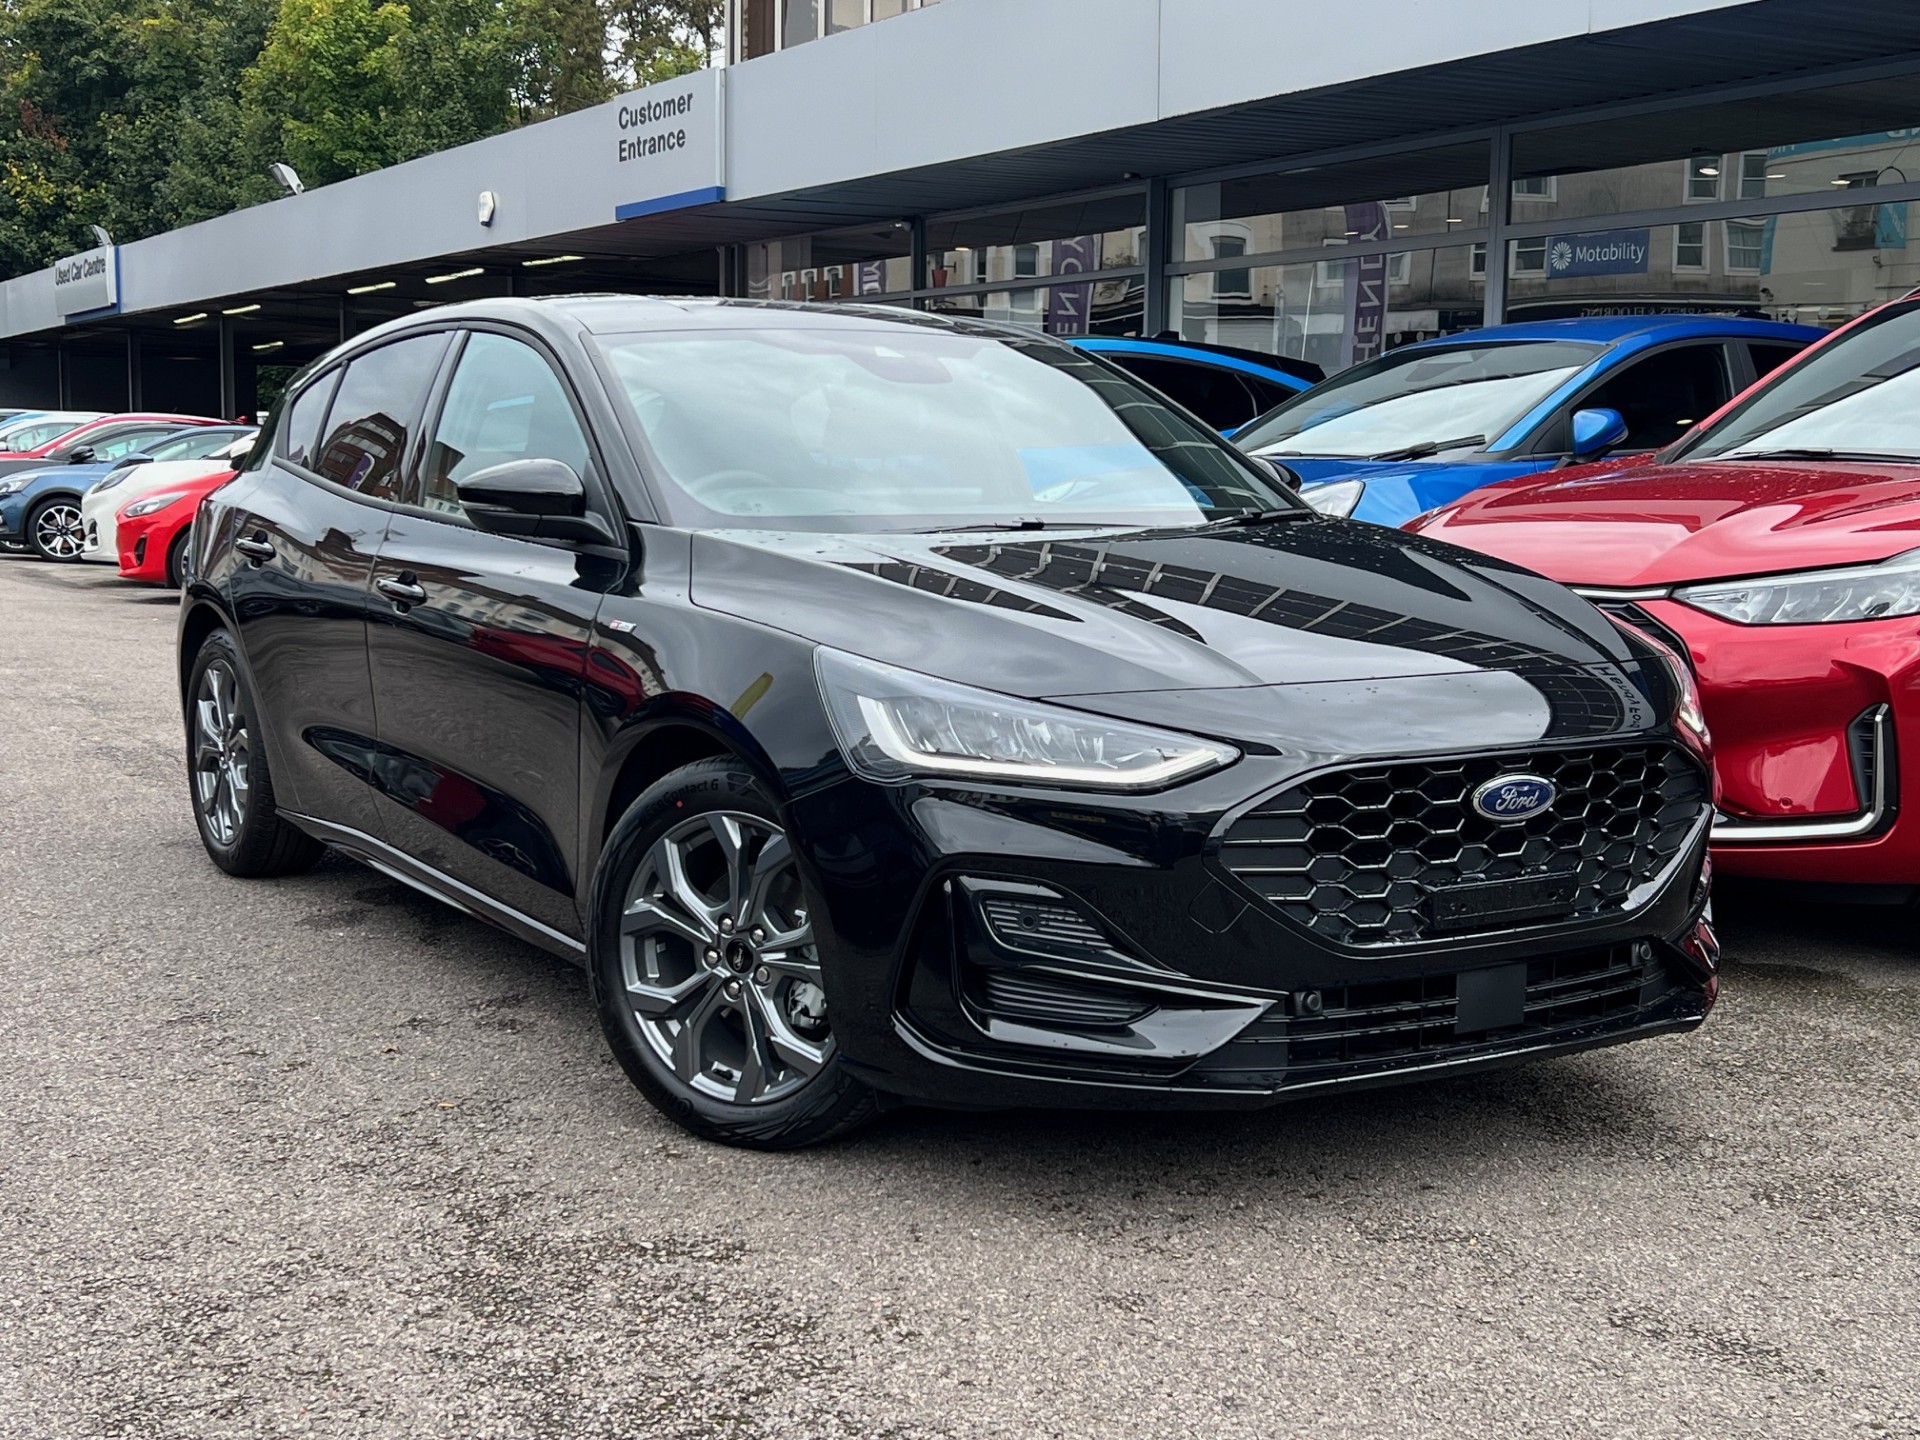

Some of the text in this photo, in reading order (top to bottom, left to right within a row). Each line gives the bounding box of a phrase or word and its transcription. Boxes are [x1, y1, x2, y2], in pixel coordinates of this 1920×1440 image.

[618, 92, 694, 130] Customer
[618, 128, 686, 163] Entrance
[1575, 242, 1645, 264] Motability
[55, 256, 106, 286] Used Car Centre
[1496, 785, 1540, 811] Ford
